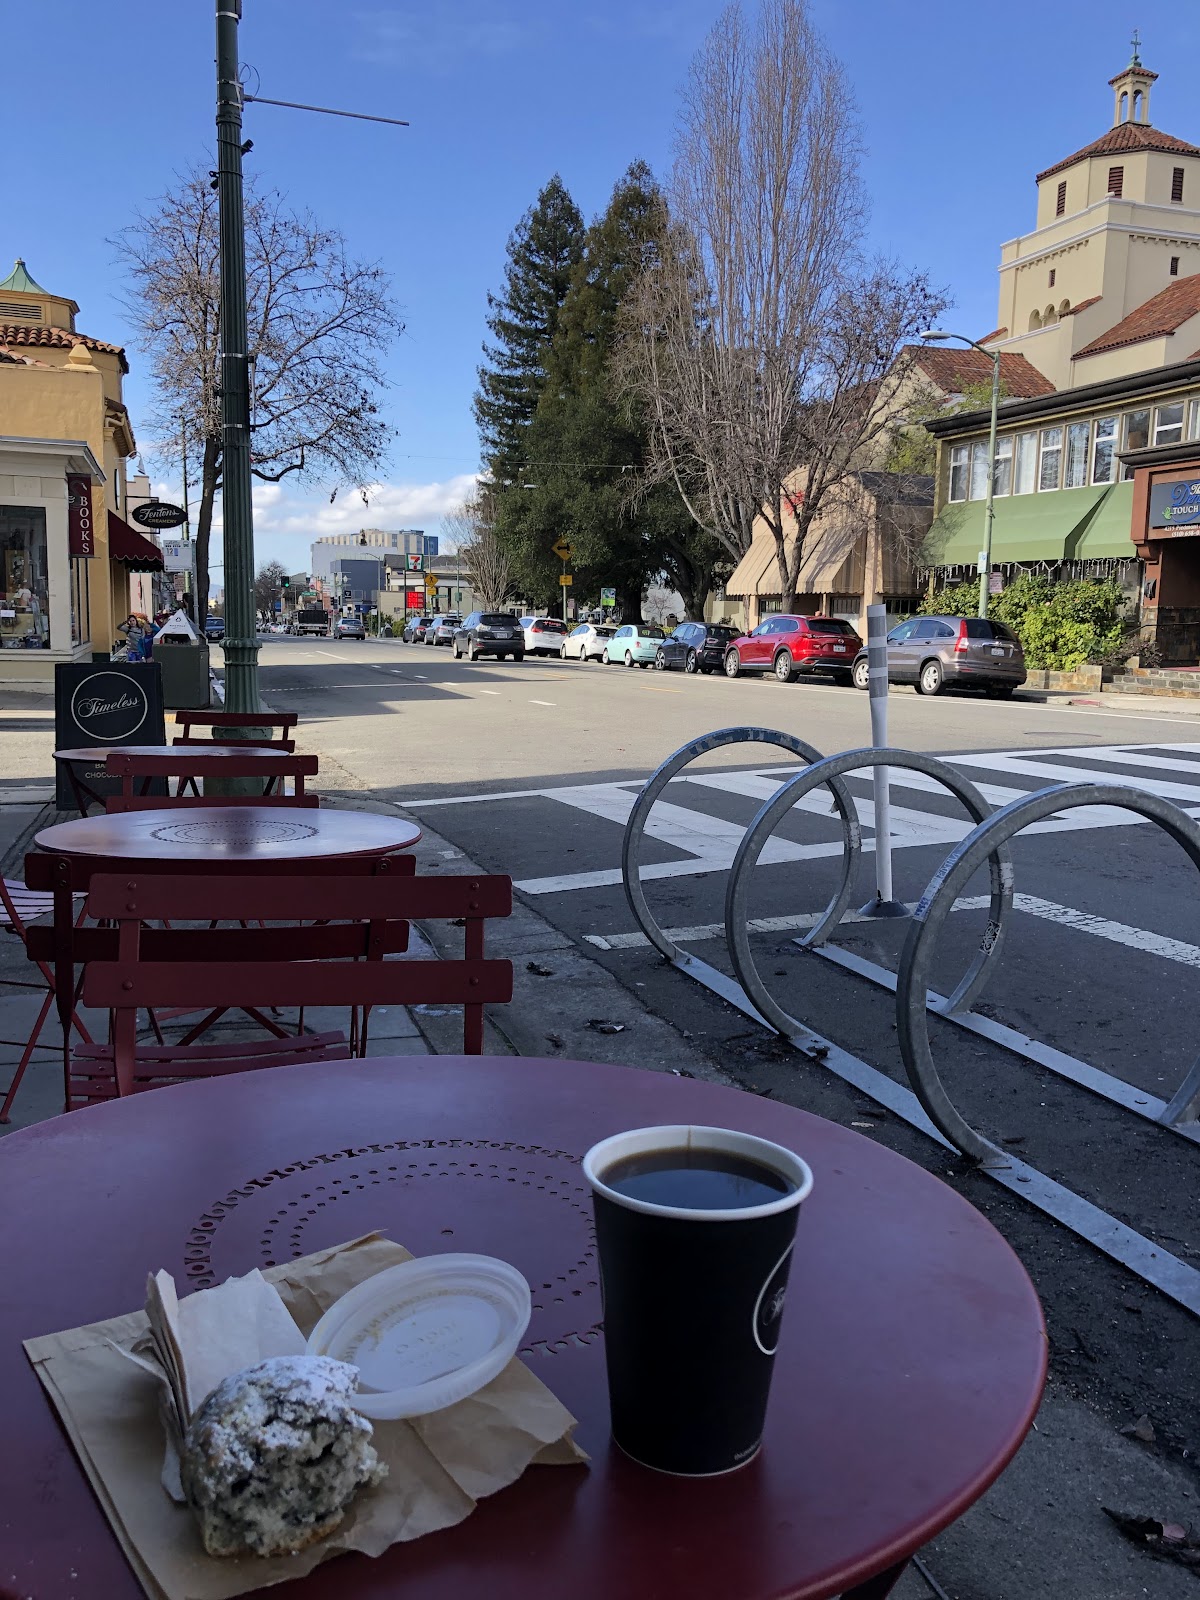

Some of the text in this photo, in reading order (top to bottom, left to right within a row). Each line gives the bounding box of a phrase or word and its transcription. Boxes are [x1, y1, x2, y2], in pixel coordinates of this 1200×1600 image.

[138, 507, 180, 521] Fentons
[1172, 505, 1199, 515] TOUCH
[79, 496, 90, 553] BOOKS
[77, 692, 139, 718] Timeless
